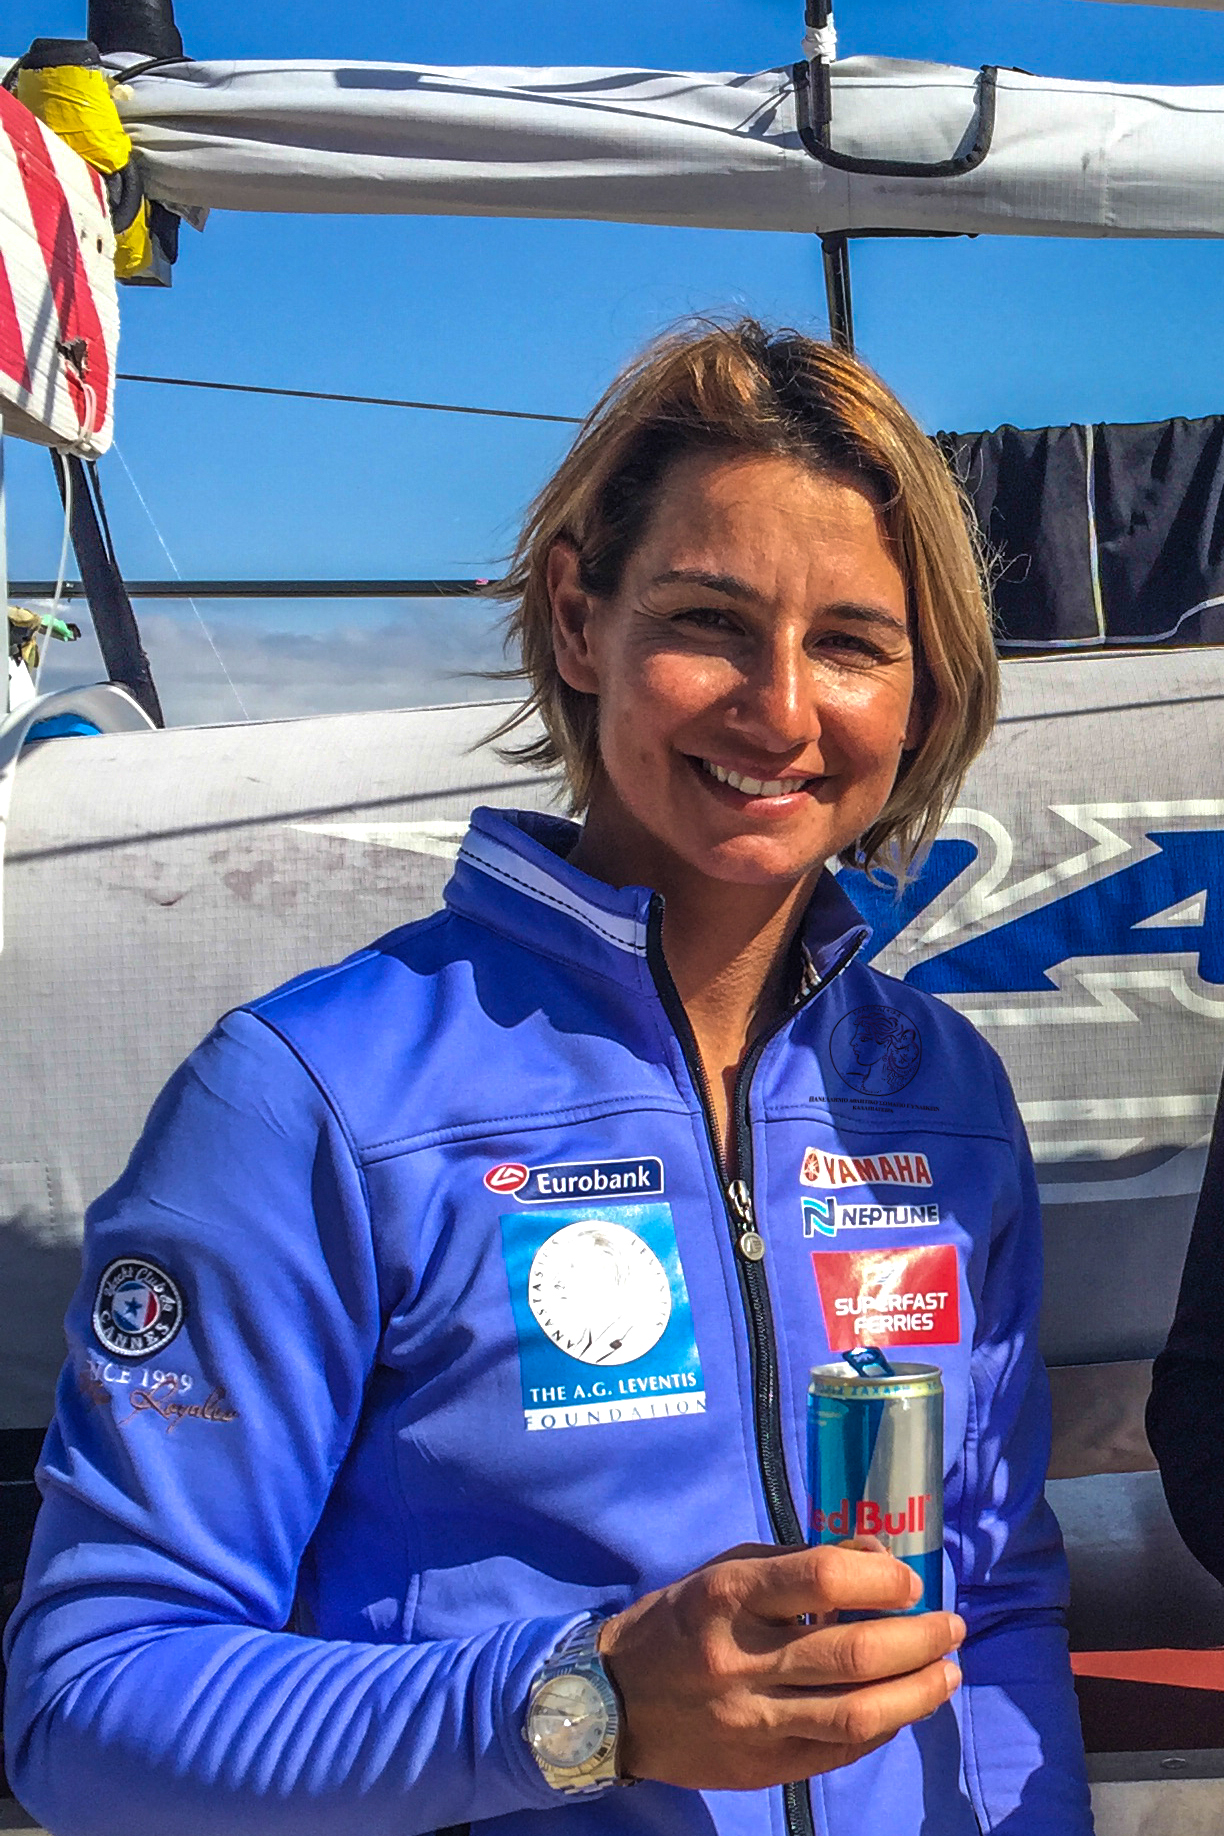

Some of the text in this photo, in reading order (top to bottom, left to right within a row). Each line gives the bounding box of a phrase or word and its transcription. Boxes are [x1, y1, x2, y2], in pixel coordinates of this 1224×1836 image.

[537, 1166, 651, 1193] Eurobank
[824, 1155, 932, 1184] YAMAHA
[842, 1206, 938, 1226] NEPTUNE
[834, 1293, 949, 1316] SUPERFAST
[100, 1310, 170, 1350] CANNES
[854, 1313, 934, 1334] FERRIES
[529, 1372, 698, 1402] THE A.G. LEVENTIS
[525, 1400, 706, 1428] FOUNDATION
[806, 1495, 926, 1535] ed Bull
